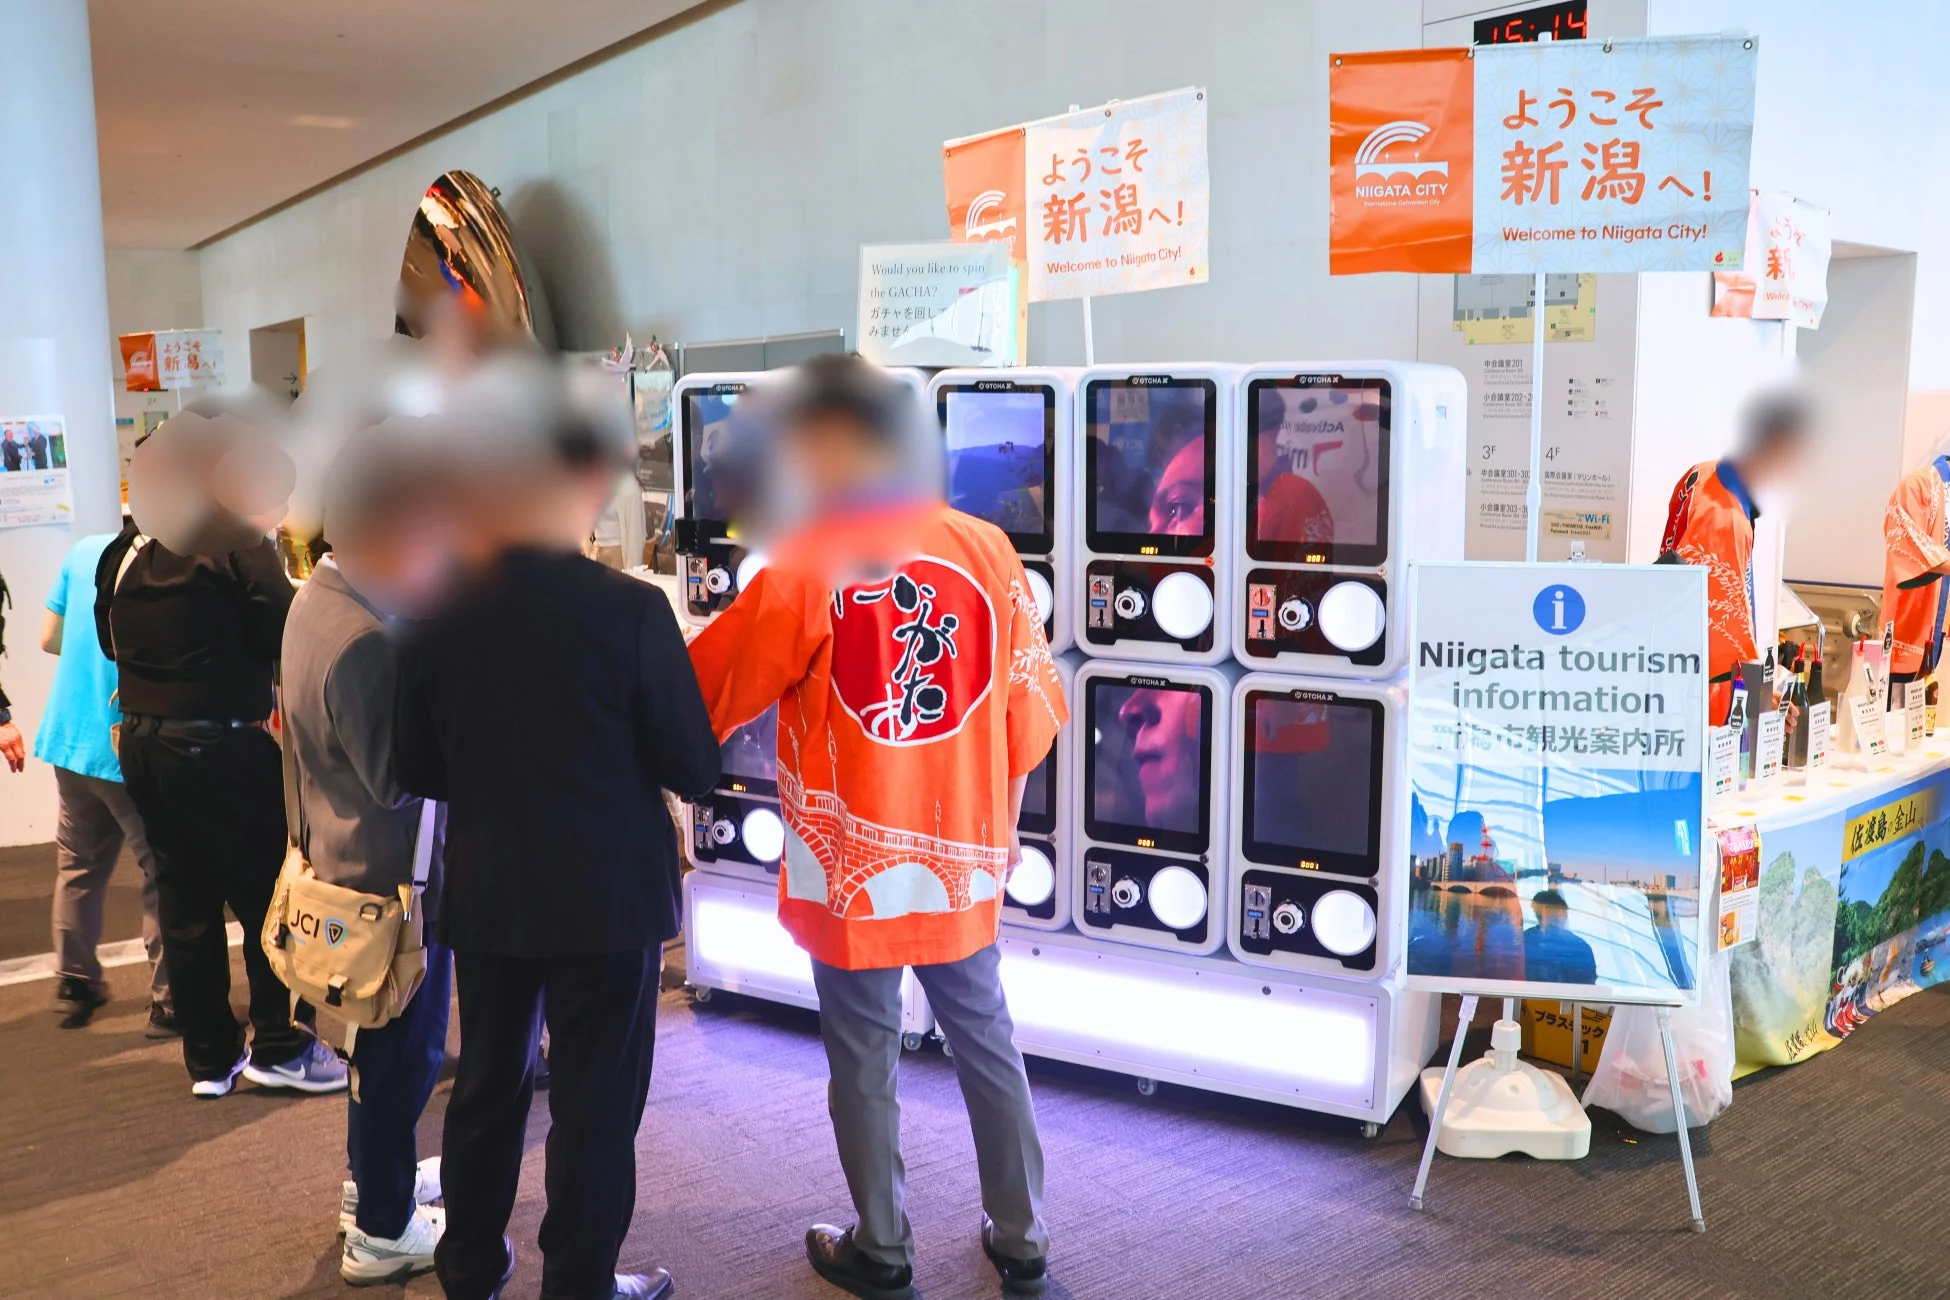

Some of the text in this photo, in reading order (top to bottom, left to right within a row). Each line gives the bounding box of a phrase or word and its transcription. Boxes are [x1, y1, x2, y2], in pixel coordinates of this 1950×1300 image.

[1492, 9, 1588, 44] 15:14
[1502, 87, 1664, 130] ようこそ
[1042, 138, 1149, 186] ようこそ
[1355, 183, 1448, 198] NIIGATA CITY
[1503, 224, 1707, 243] Welcome to Niigata City!
[872, 262, 985, 277] Would you like to spin
[1047, 246, 1182, 274] Welcome to Niigata City!
[870, 286, 938, 298] the GACHA?
[163, 341, 202, 353] ようこそ
[1482, 445, 1496, 460] 3F
[1545, 446, 1560, 461] 4F
[1584, 513, 1610, 524] Wi-Fi
[1419, 641, 1700, 675] Niigata tourism
[1453, 681, 1664, 714] information
[290, 908, 320, 939] JCI
